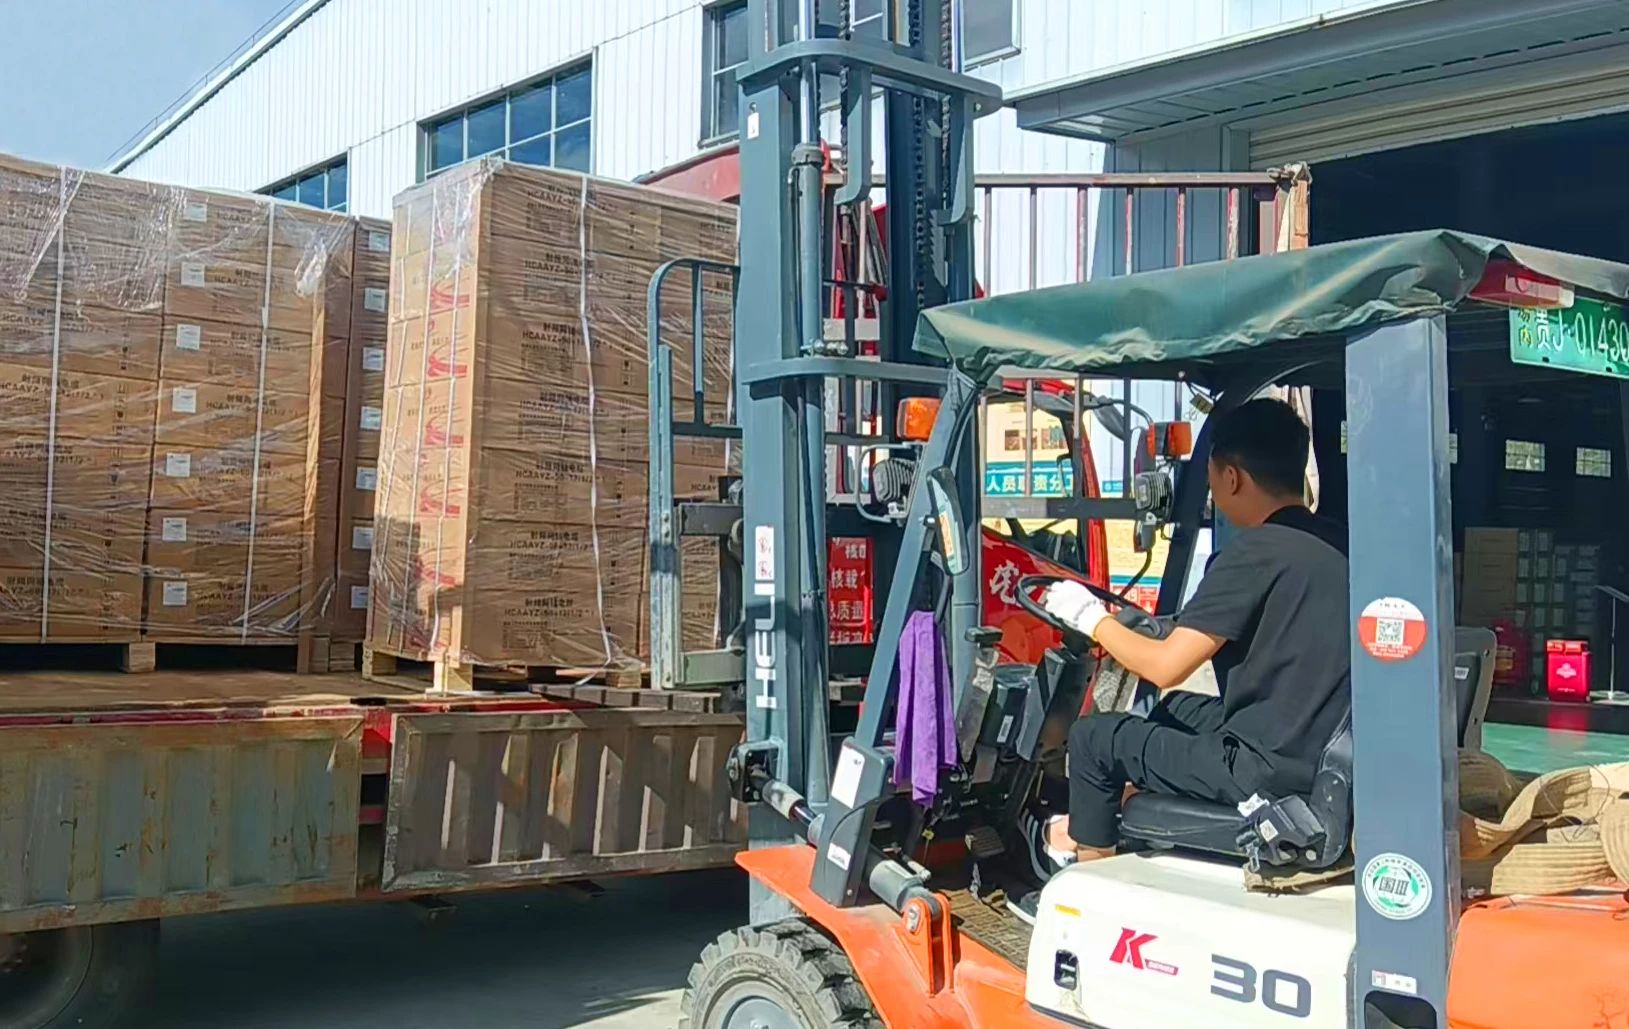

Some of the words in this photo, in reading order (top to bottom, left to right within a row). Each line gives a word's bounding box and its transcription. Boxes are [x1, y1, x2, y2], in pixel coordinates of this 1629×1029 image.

[754, 583, 777, 709] HELI
[1109, 927, 1158, 970] K
[1210, 953, 1312, 1018] 30
